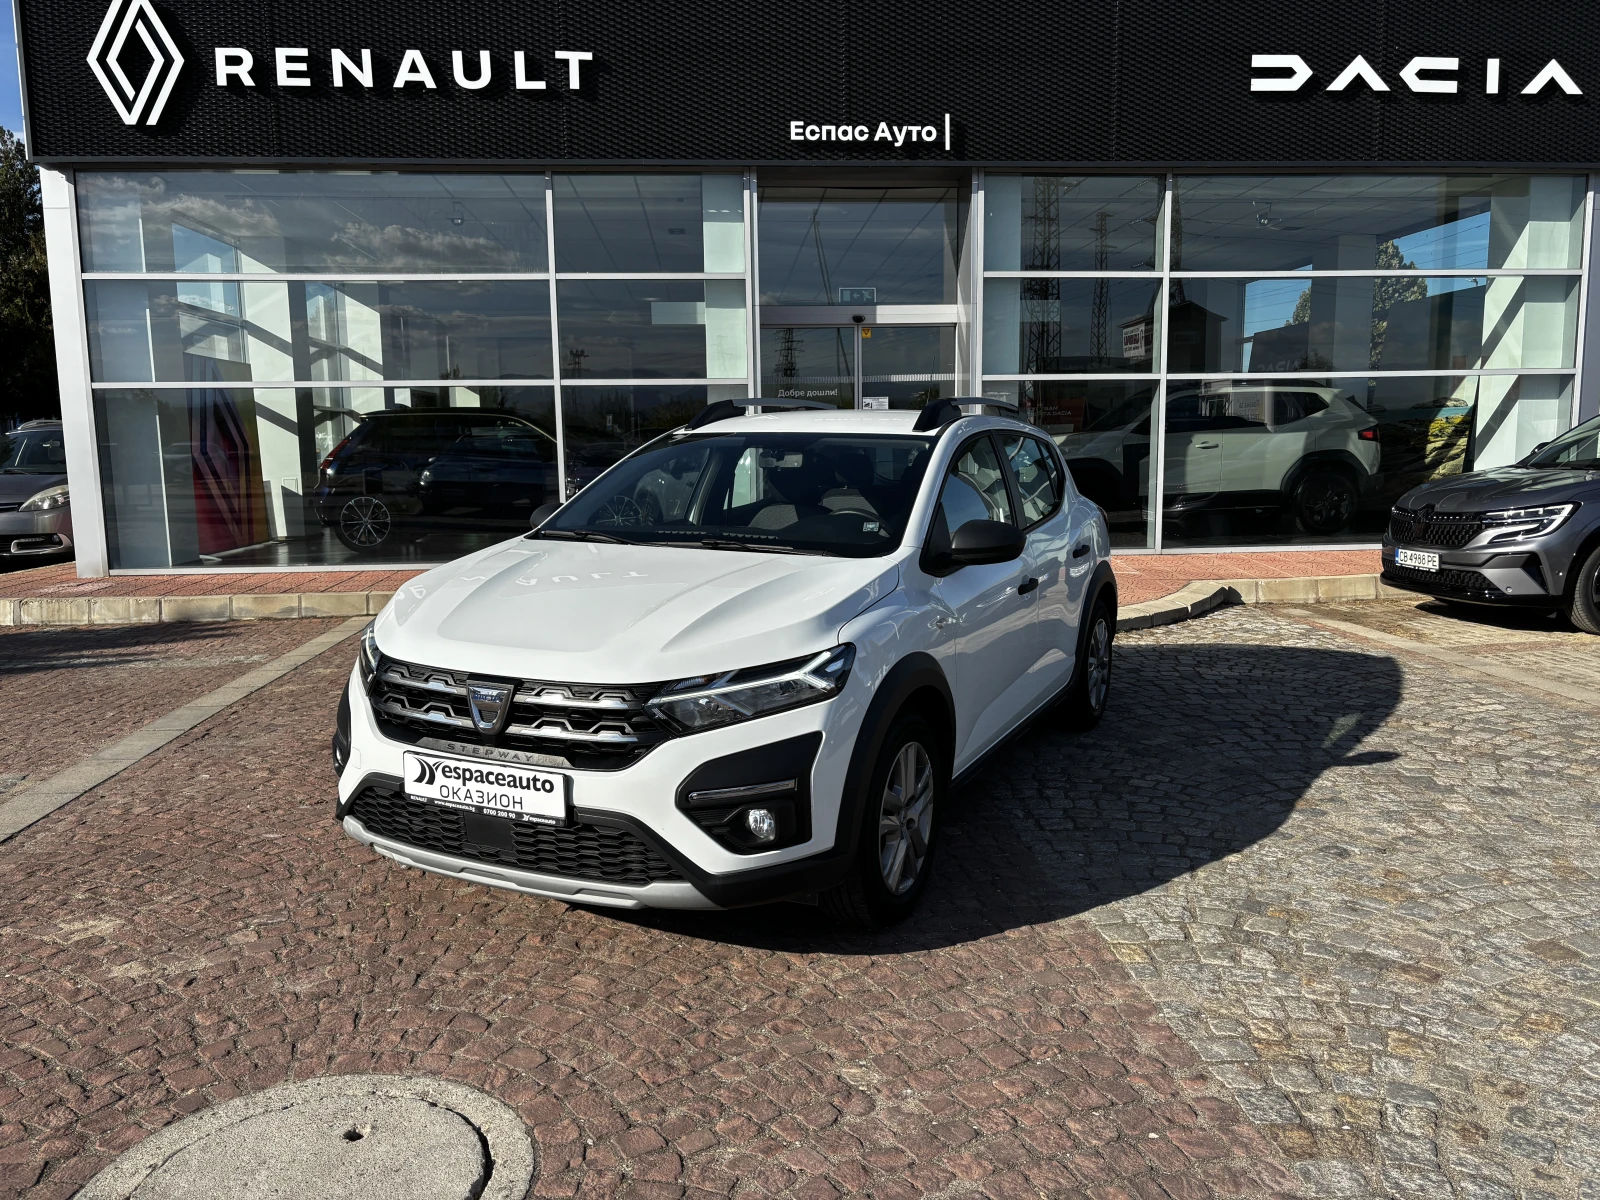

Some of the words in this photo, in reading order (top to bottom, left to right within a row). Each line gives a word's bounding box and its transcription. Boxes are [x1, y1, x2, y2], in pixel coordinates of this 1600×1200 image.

[214, 47, 593, 90] RENAULT
[1250, 54, 1583, 94] DACIA
[790, 121, 870, 141] Еспас
[874, 122, 937, 147] Ауто
[778, 389, 805, 398] Добре
[807, 389, 838, 398] дошли!
[446, 743, 533, 762] STEPWAY
[441, 764, 555, 793] espaceauto
[439, 785, 523, 810] ОКАЗИОН
[483, 808, 497, 816] 0700
